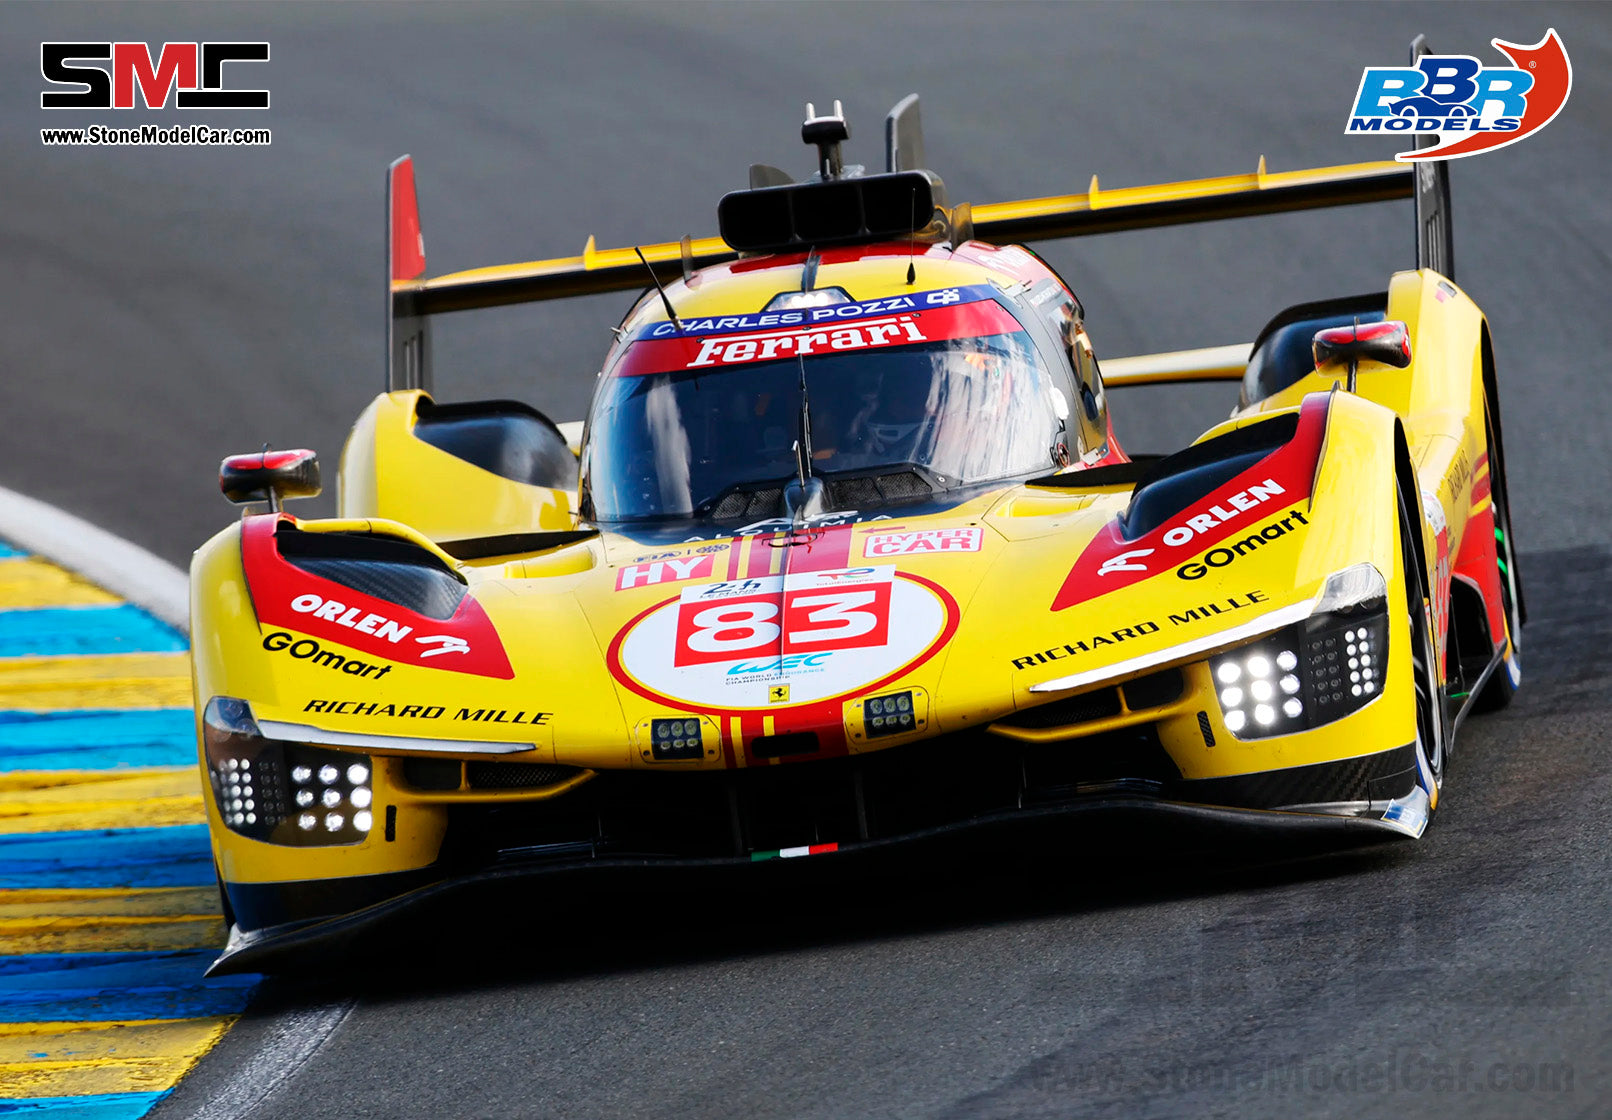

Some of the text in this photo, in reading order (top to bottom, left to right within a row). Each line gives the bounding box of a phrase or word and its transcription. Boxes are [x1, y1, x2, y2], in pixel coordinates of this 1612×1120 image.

[652, 297, 915, 337] CHARLES POZZI
[686, 315, 928, 368] Ferrari
[1162, 478, 1287, 547] ORLEN
[873, 537, 971, 554] CAR
[874, 530, 973, 543] HYPER
[1176, 509, 1310, 581] GOmart
[621, 555, 709, 589] HY
[291, 594, 414, 644] ORLEN
[687, 590, 878, 653] 83
[1011, 589, 1270, 670] RICHARD MILLE
[262, 631, 392, 680] GOmart
[727, 652, 834, 675] WEC
[725, 675, 791, 686] CHAMPIONSHIP
[303, 700, 553, 726] RICHARD MILLE
